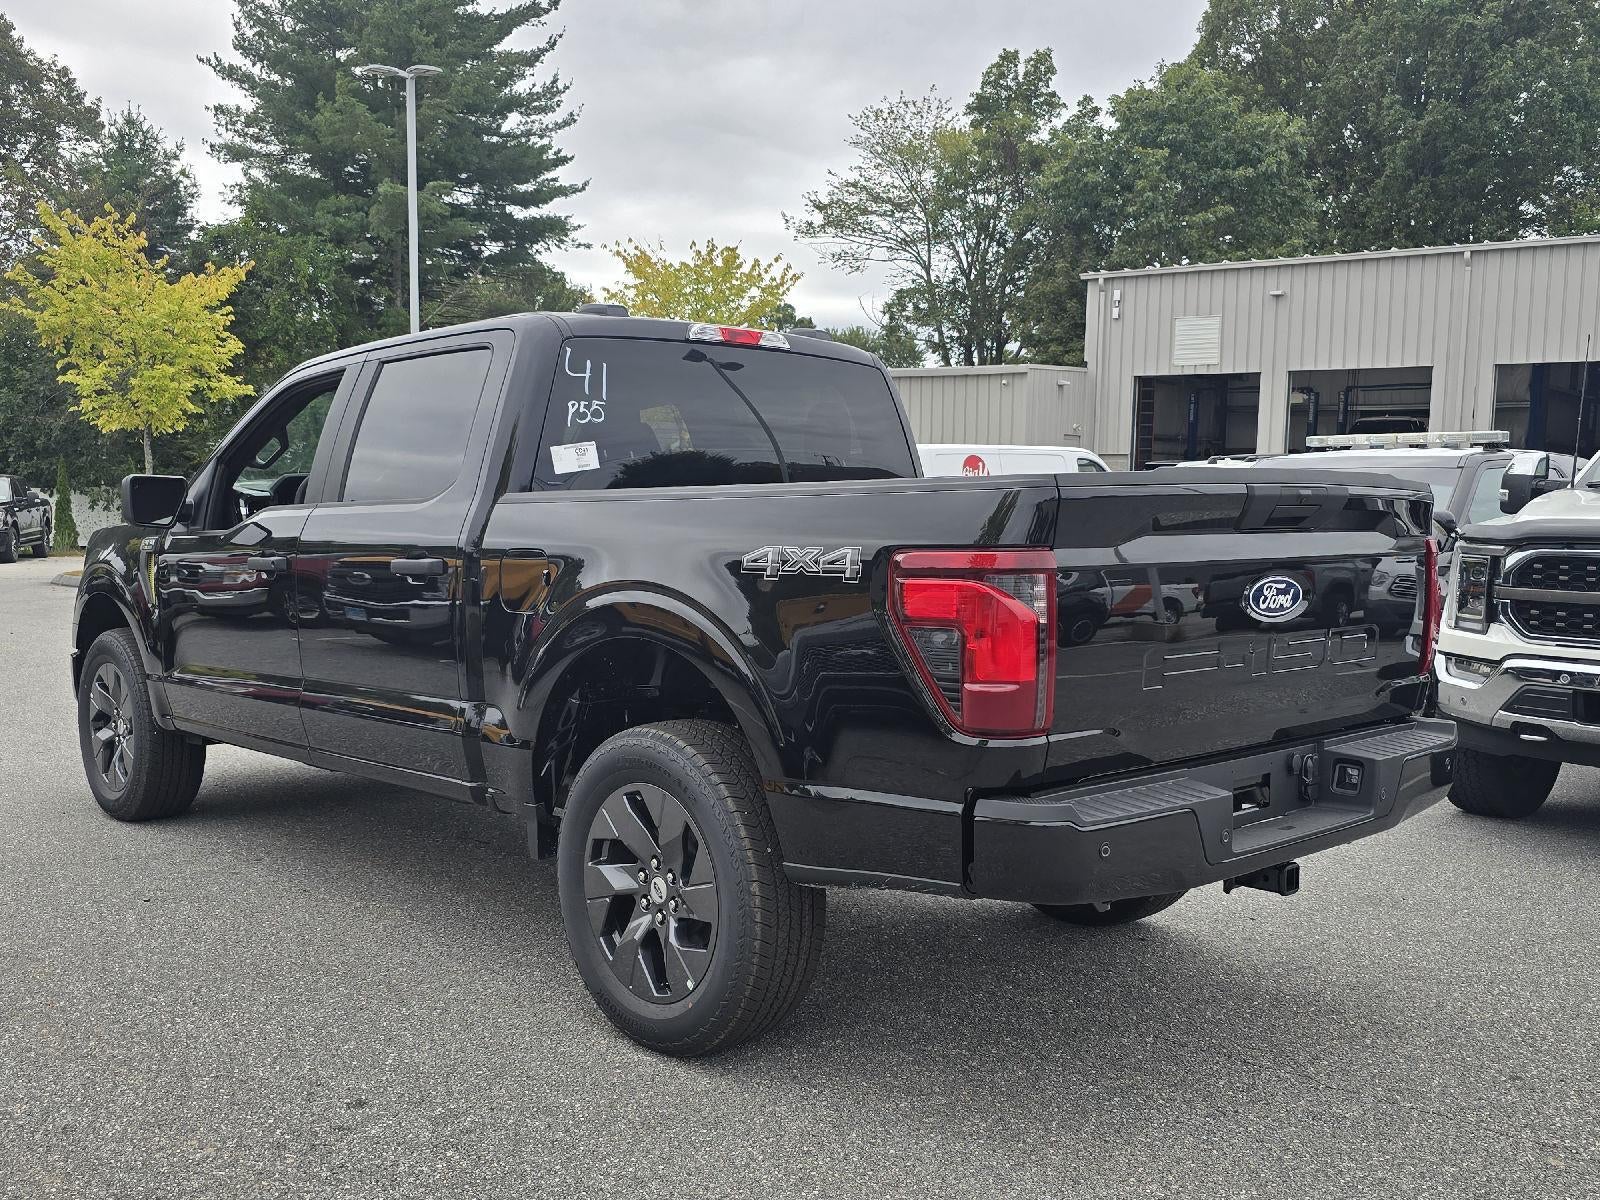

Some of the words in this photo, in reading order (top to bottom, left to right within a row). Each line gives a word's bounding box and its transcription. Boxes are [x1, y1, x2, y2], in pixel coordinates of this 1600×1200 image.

[565, 346, 607, 400] 41
[567, 400, 606, 427] P55
[1260, 583, 1295, 609] Ford
[1142, 625, 1379, 691] F-150
